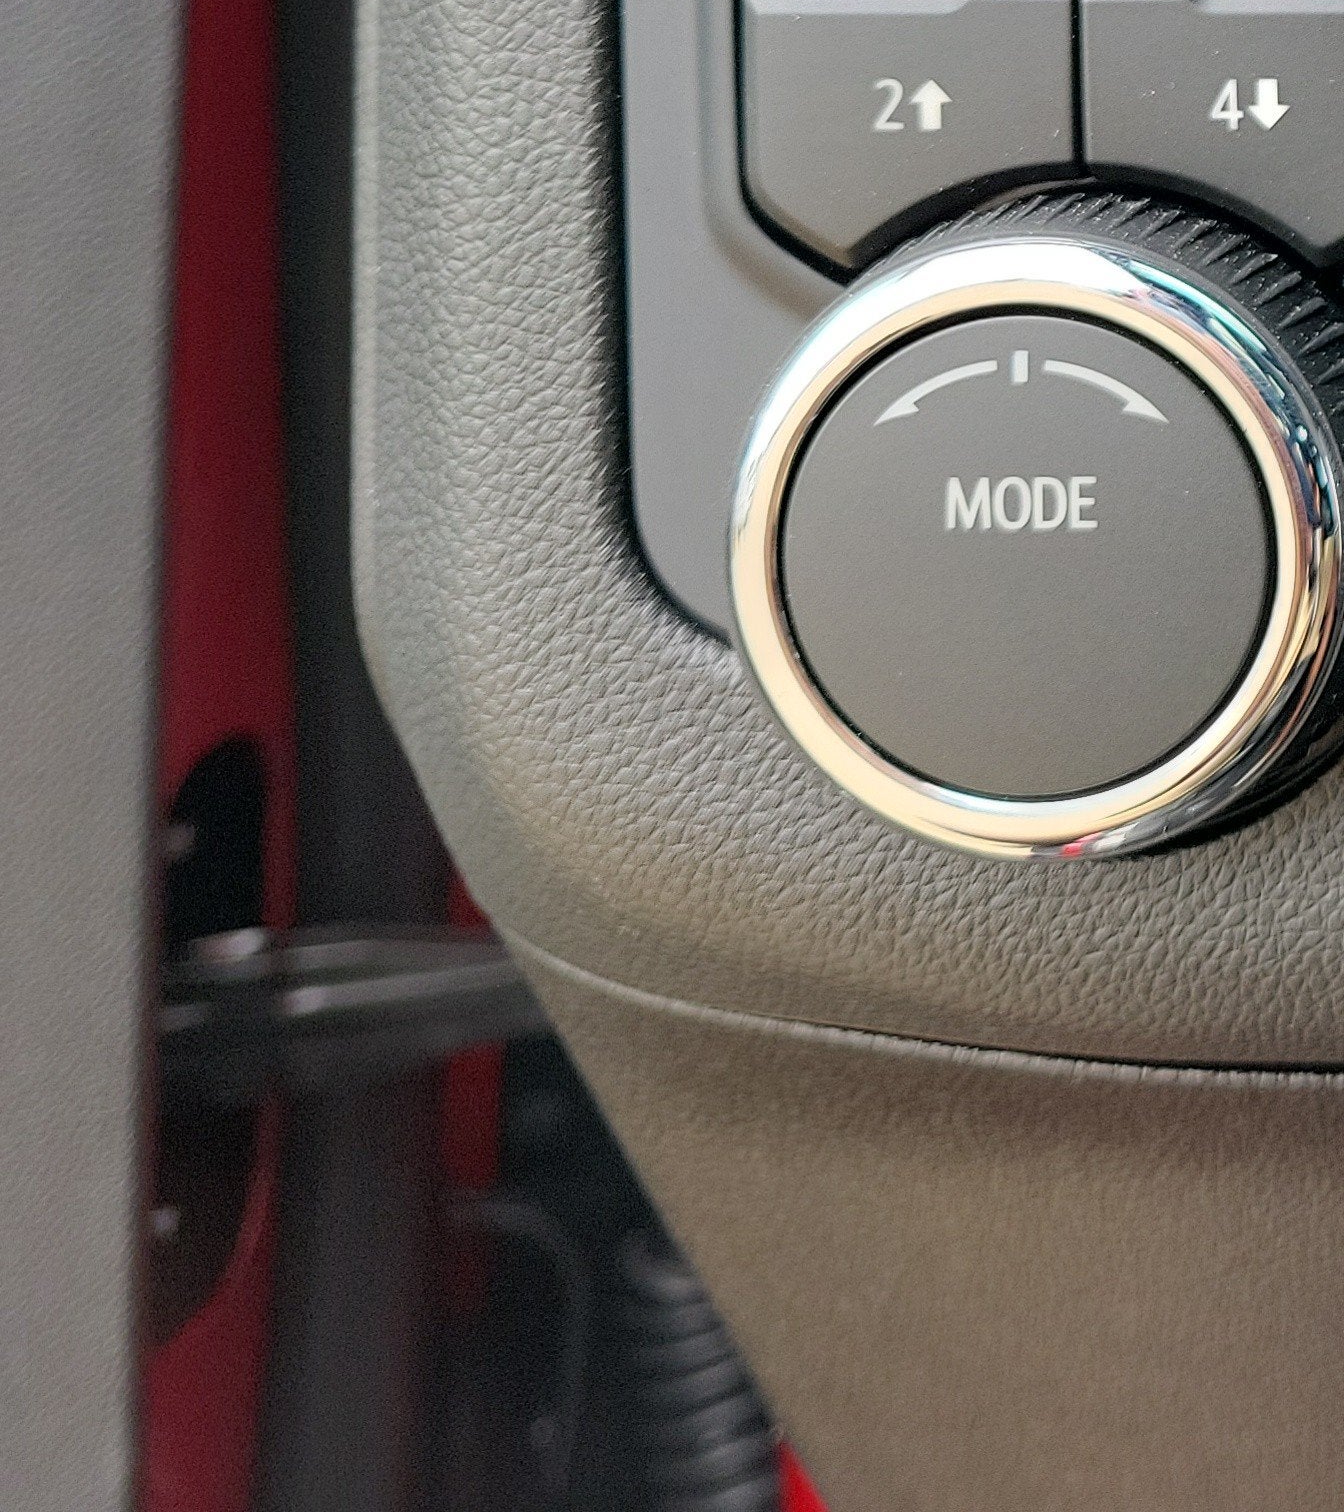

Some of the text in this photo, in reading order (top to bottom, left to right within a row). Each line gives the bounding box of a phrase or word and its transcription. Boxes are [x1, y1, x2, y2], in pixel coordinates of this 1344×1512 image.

[873, 79, 905, 131] 2
[1209, 79, 1244, 131] 4
[944, 475, 1099, 531] MODE
